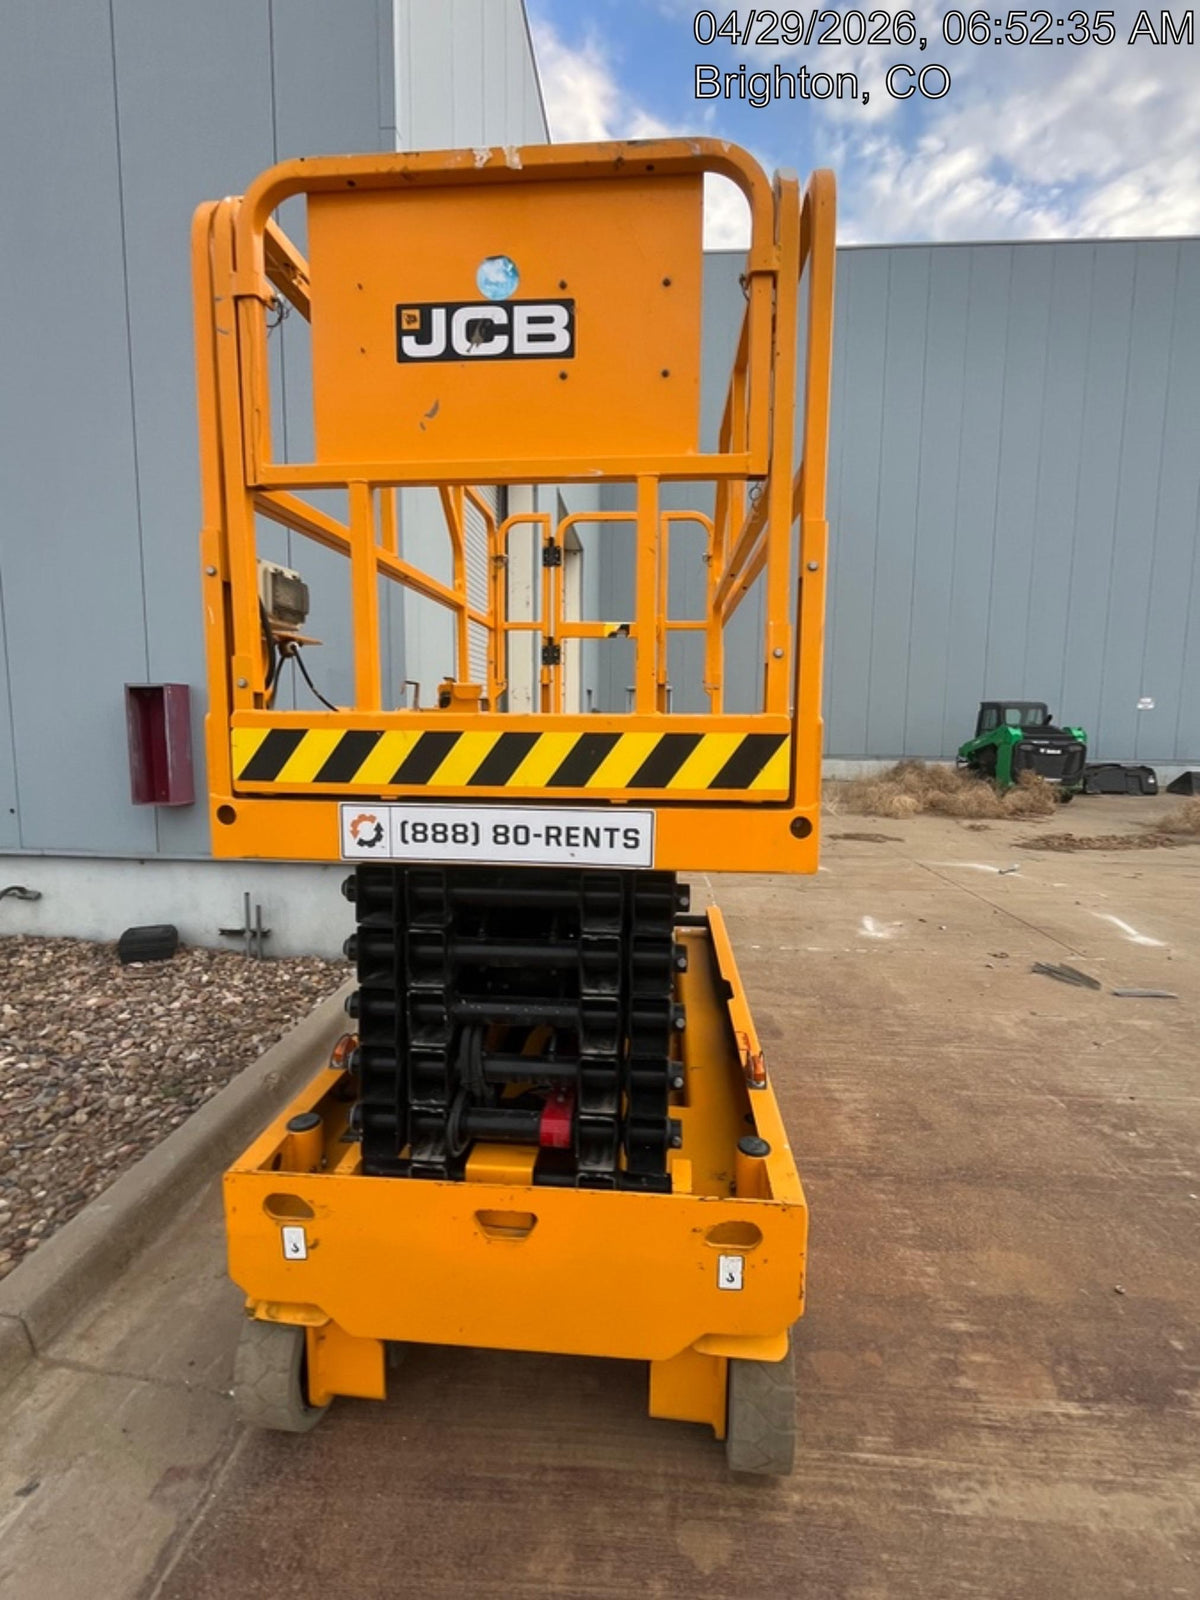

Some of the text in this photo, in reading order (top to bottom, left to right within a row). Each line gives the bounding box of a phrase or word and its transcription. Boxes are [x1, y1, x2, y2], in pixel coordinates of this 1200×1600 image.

[402, 305, 571, 358] JCB
[400, 820, 641, 849] (888) 80-RENTS
